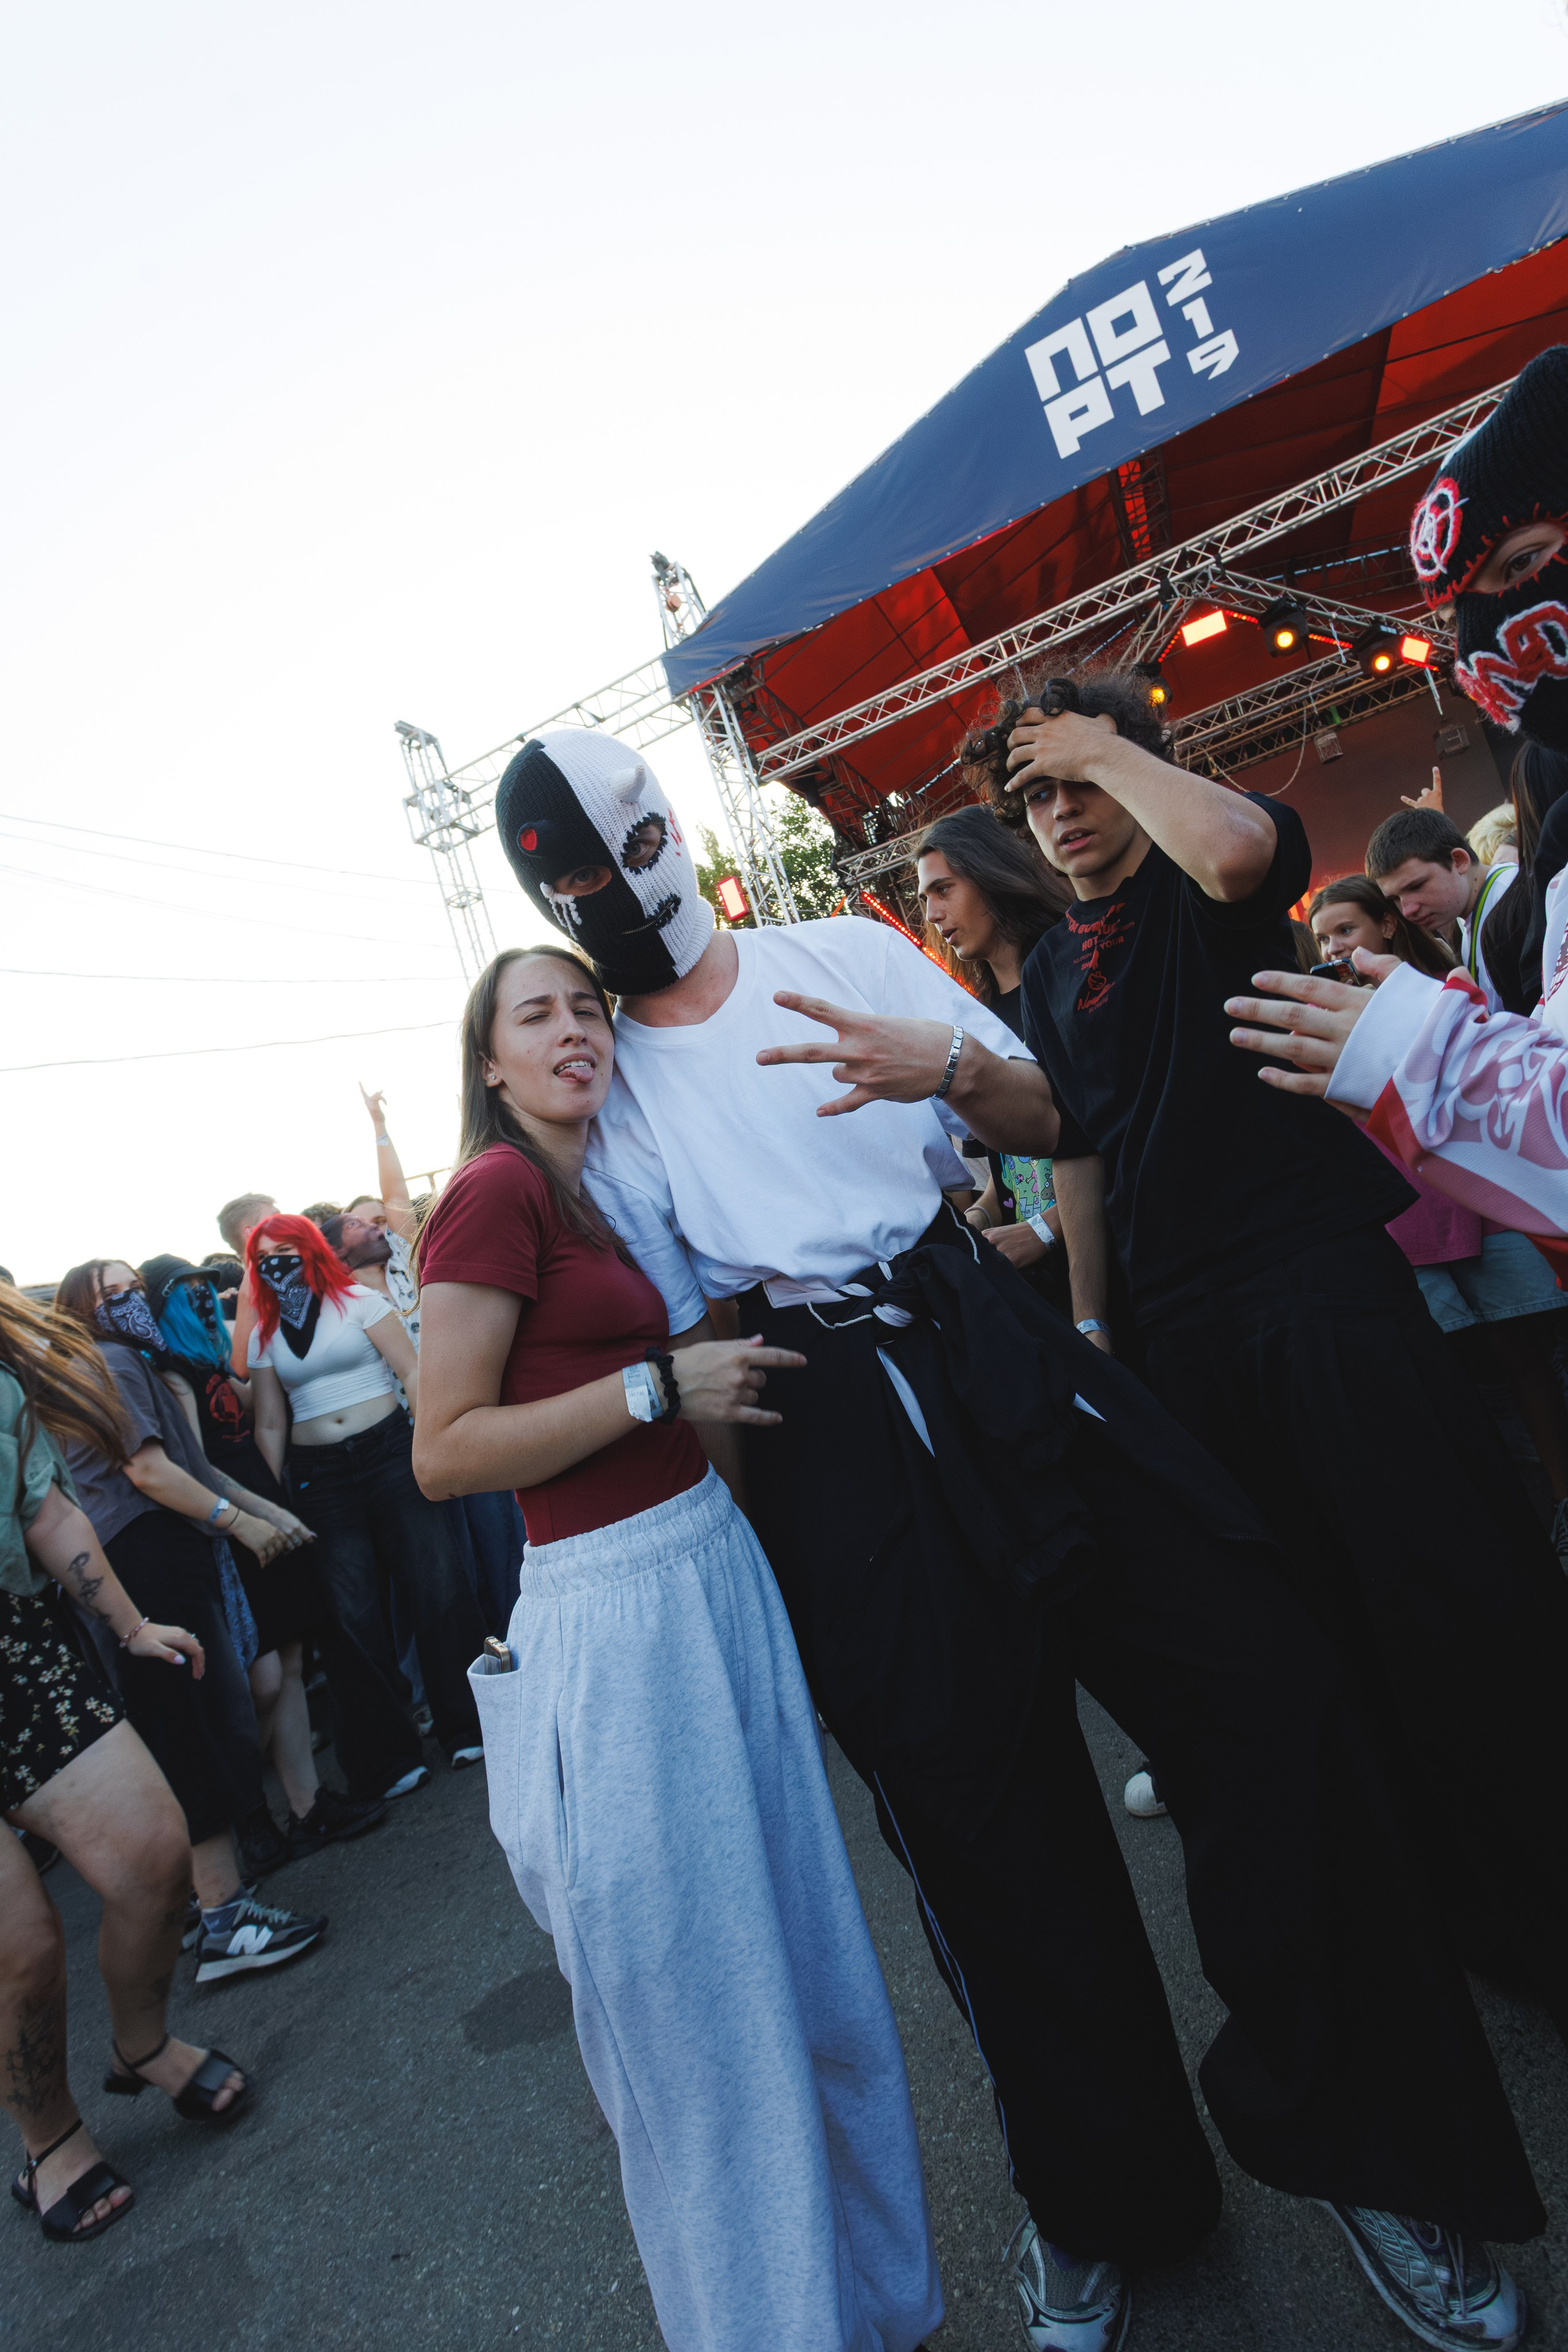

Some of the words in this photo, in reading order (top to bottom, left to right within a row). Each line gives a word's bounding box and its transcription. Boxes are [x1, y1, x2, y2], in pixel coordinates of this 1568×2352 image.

[1157, 248, 1240, 380] 219
[1082, 936, 1098, 952] HOT
[1099, 935, 1125, 950] YOUR
